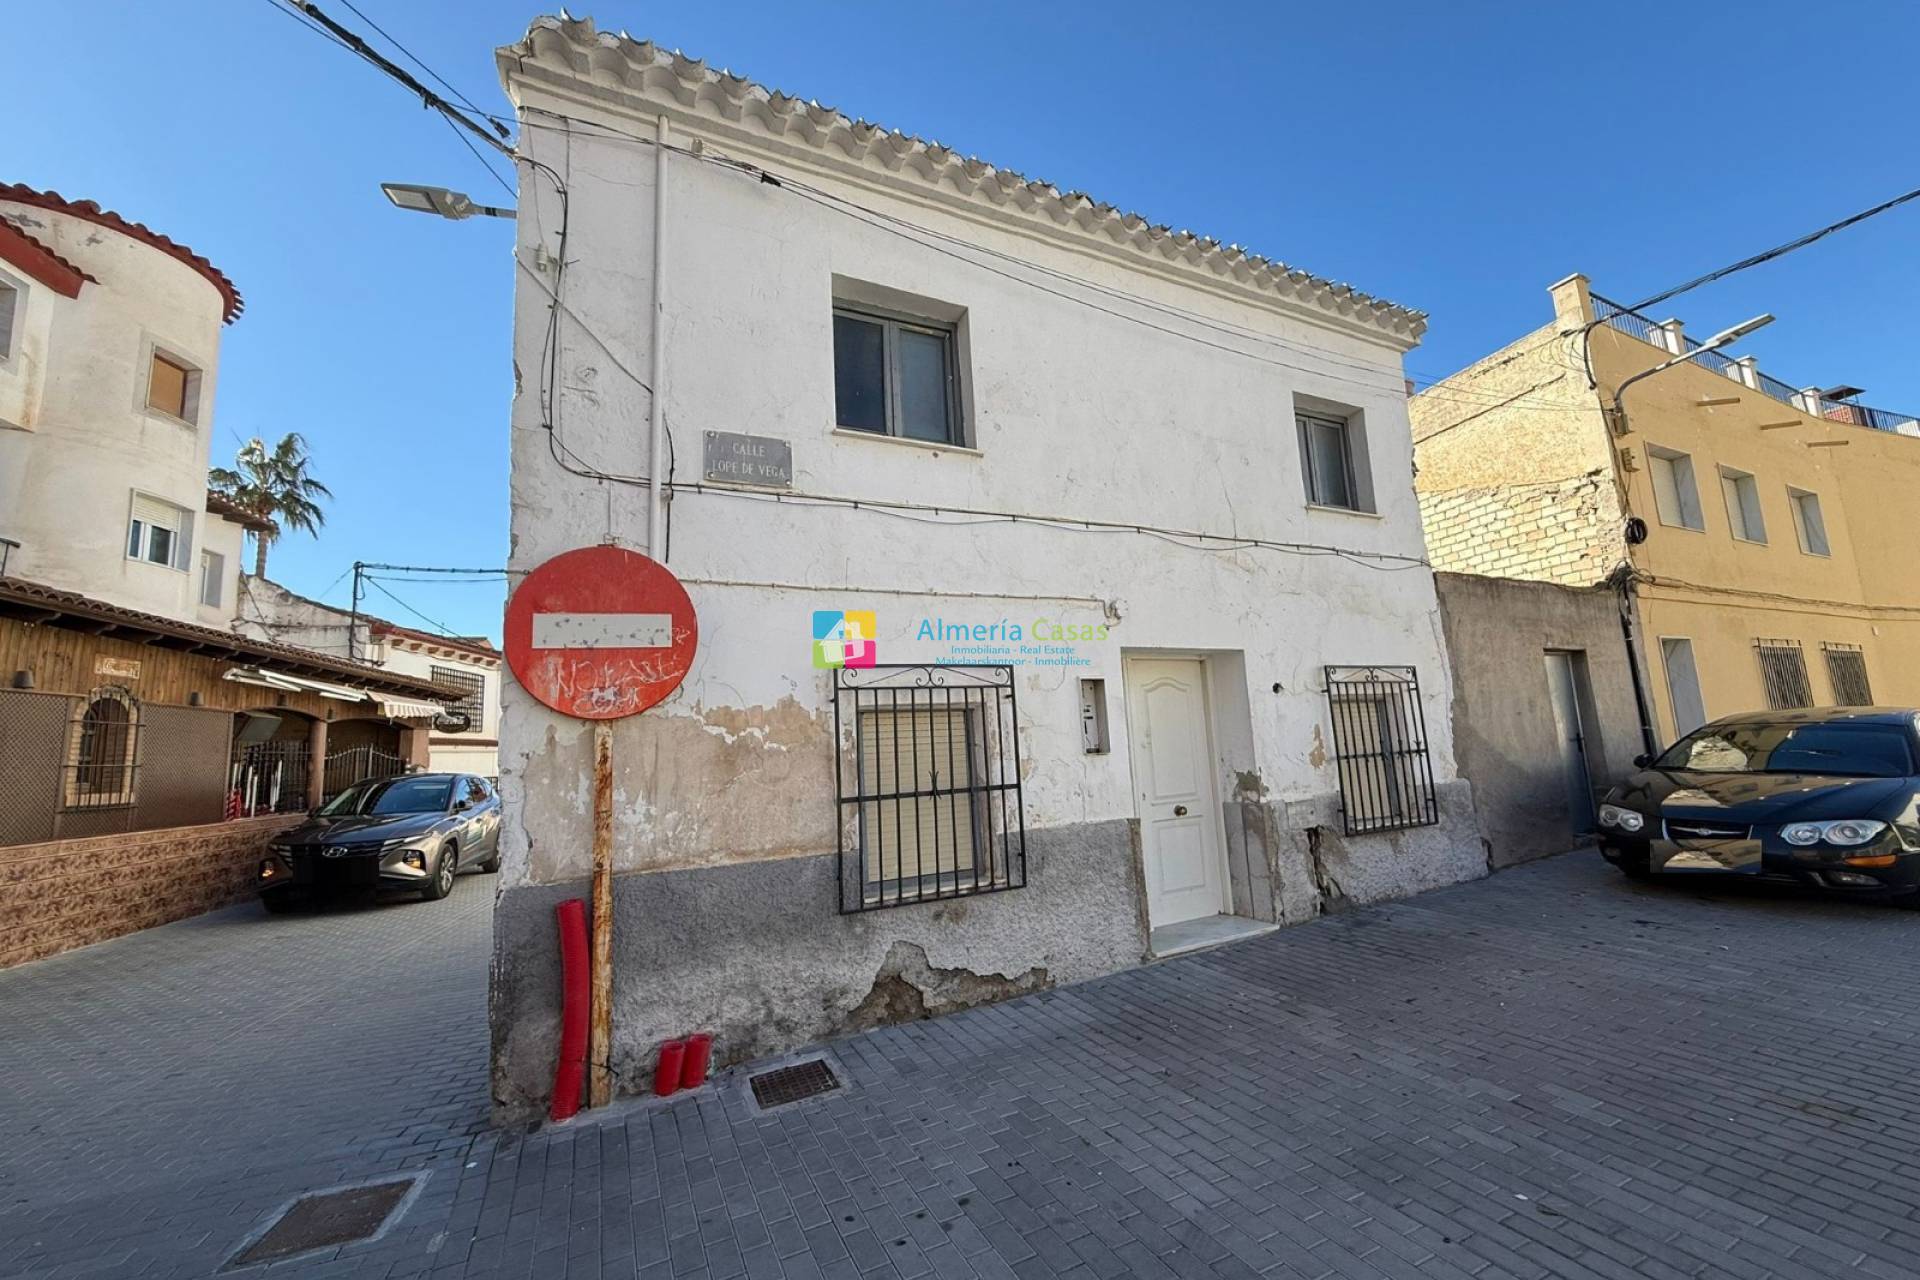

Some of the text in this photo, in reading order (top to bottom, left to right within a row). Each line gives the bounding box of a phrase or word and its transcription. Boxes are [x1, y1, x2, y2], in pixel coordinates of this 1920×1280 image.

[732, 443, 765, 456] CALLE
[712, 459, 785, 478] LOPE DE VEGA
